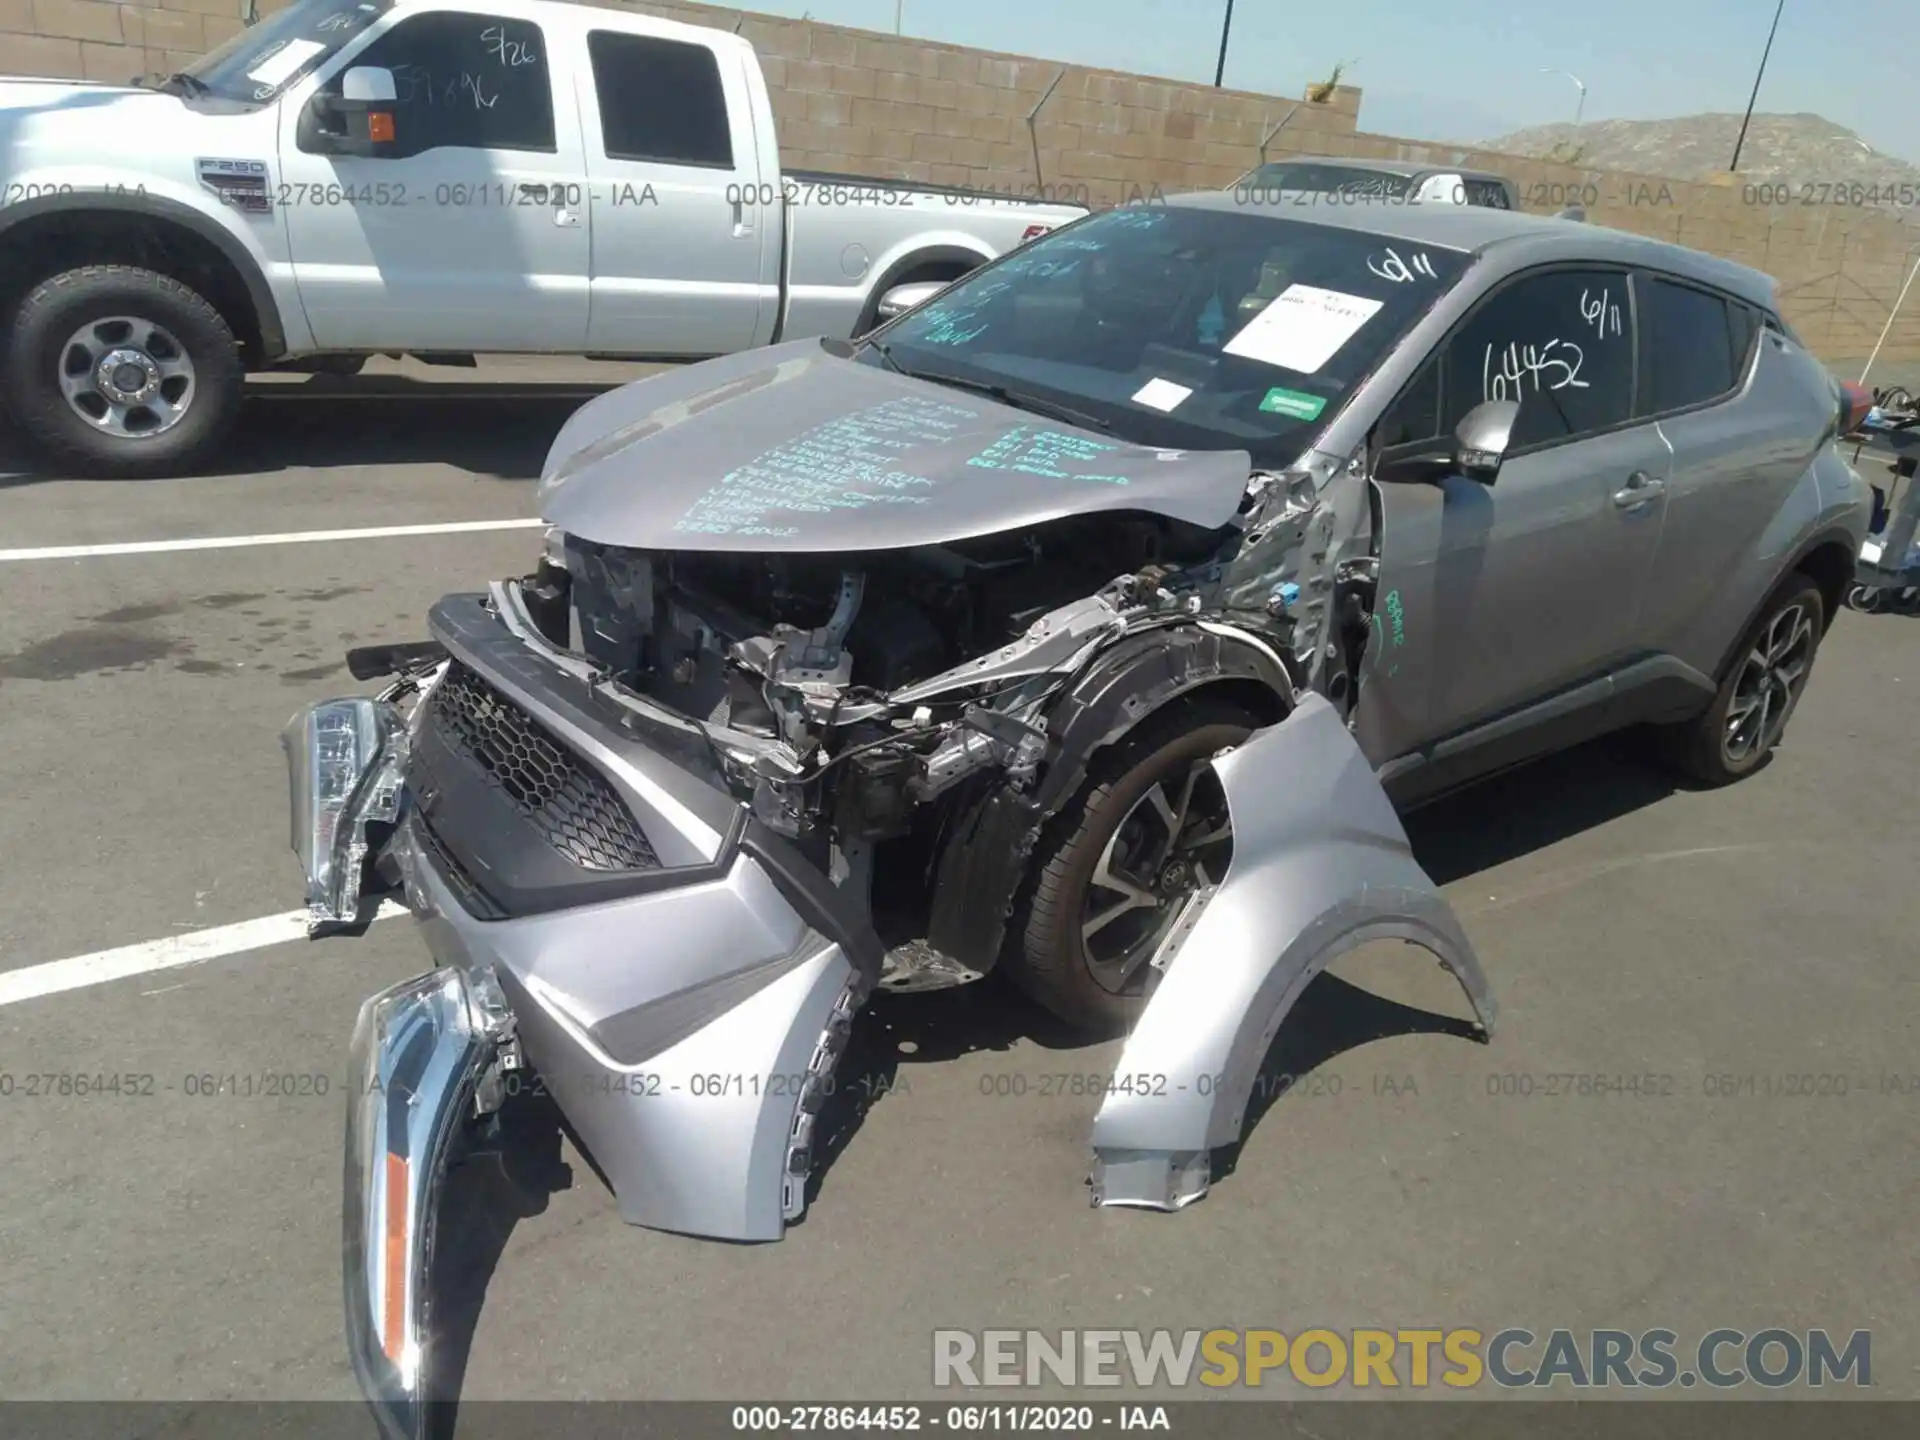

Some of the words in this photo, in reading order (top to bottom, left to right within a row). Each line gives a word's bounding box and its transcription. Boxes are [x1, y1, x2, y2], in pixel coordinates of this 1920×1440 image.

[480, 27, 537, 66] 5/26
[1581, 288, 1621, 339] 6/11
[1484, 338, 1590, 402] 64452
